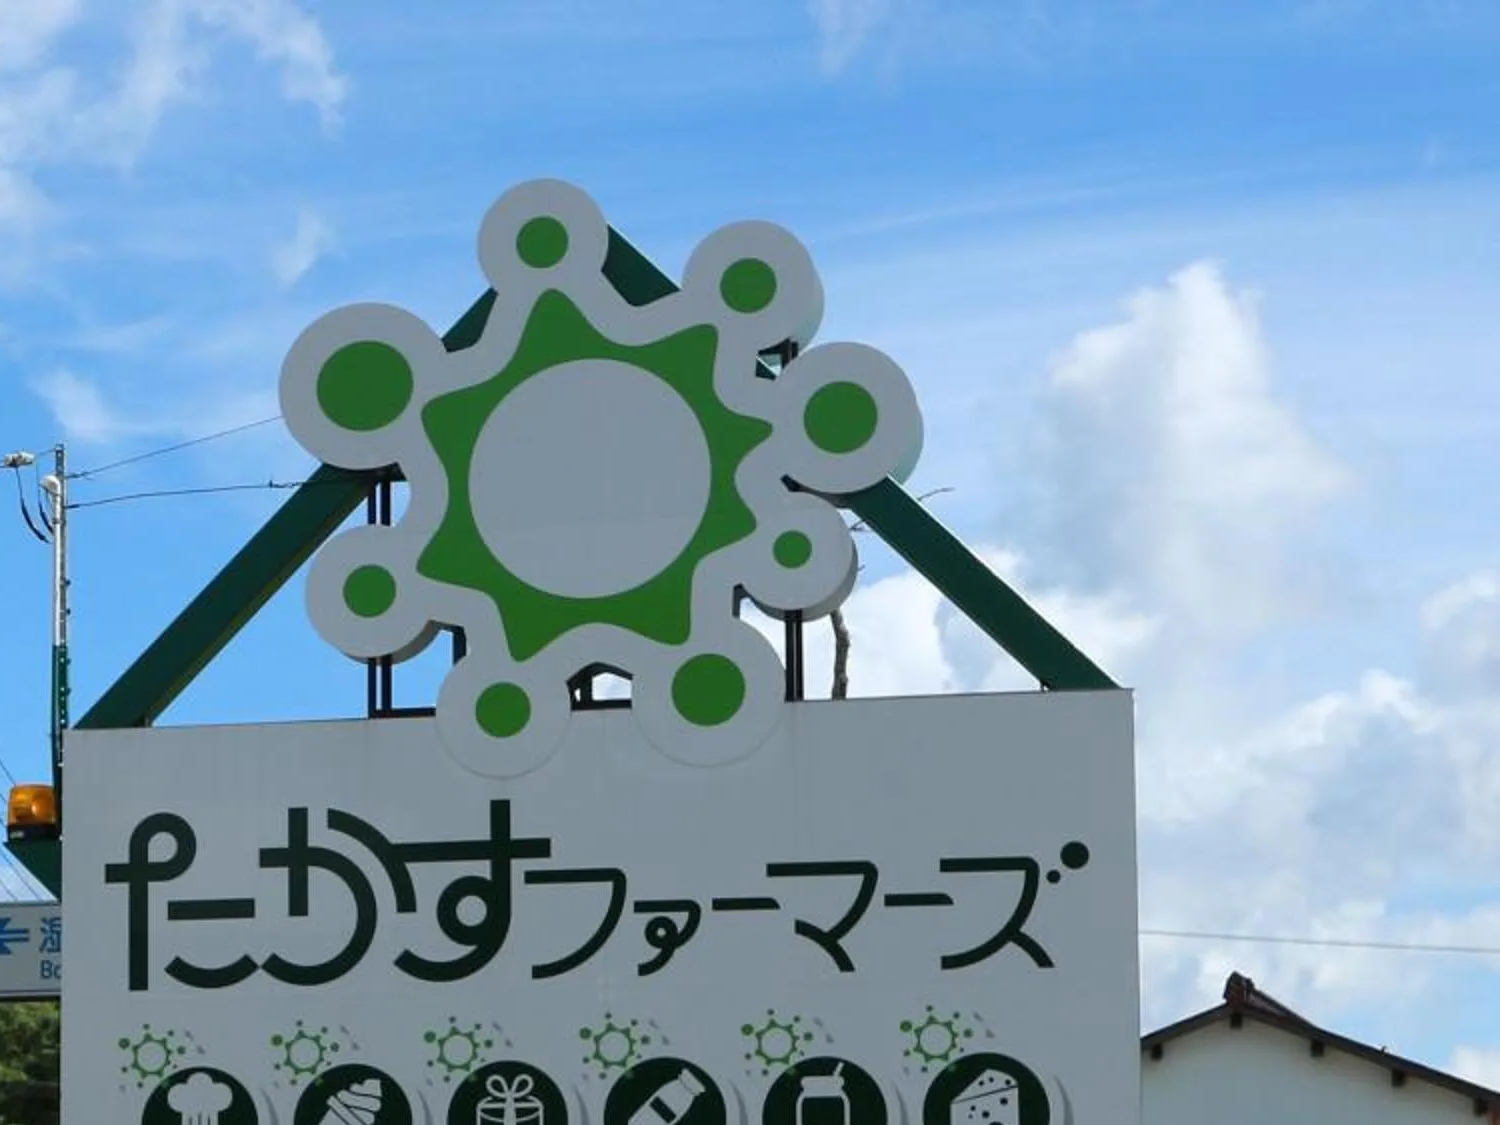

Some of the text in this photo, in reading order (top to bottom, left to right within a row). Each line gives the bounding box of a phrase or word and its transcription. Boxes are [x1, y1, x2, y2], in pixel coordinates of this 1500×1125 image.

[105, 799, 1089, 992] たかすファーマーズ
